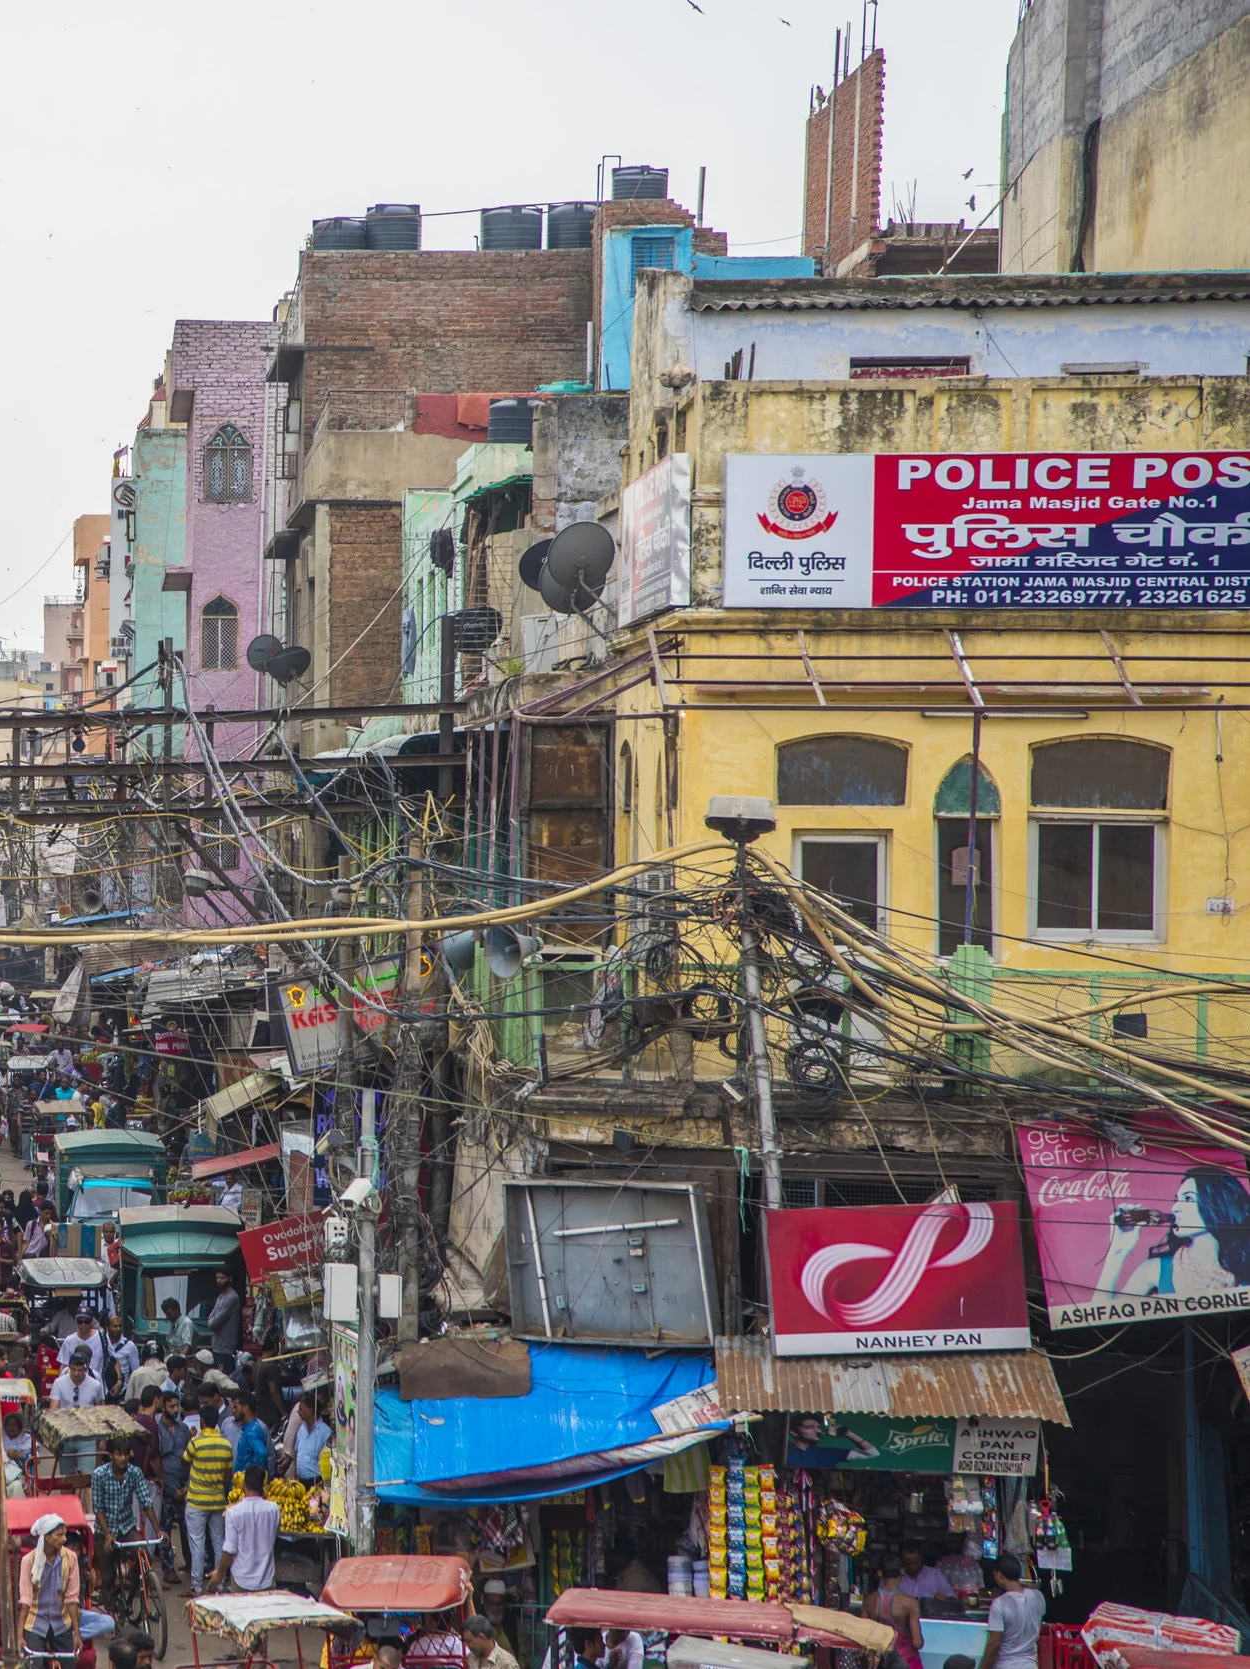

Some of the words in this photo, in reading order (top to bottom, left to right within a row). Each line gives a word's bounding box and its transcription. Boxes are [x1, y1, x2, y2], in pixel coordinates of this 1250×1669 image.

[897, 457, 1111, 491] POLICE
[962, 496, 1022, 510] Jama
[1029, 495, 1100, 512] Masjid
[1107, 495, 1161, 510] Gate
[1168, 495, 1217, 509] No.1
[900, 513, 1097, 559] पुलिस
[747, 550, 794, 571] दिल्ली
[799, 551, 846, 576] पुलिस
[968, 555, 1030, 568] जामा
[1034, 552, 1120, 569] मस्जिद
[1124, 551, 1165, 568] गेट
[1168, 551, 1199, 568] नं.
[1209, 555, 1220, 567] 1
[788, 583, 807, 595] सेवा
[809, 585, 832, 595] न्याय
[892, 577, 948, 587] POLICE
[952, 576, 1020, 588] STATION
[1024, 576, 1067, 588] JAMA
[1072, 576, 1131, 588] MASJID
[1135, 576, 1209, 588] CENTRAL
[931, 591, 968, 604] PH:
[974, 590, 1132, 607] 011-23269777,
[1138, 590, 1246, 604] 23261625
[1027, 1124, 1070, 1150] get
[1059, 1303, 1136, 1325] ASHFAQ
[1141, 1298, 1179, 1317] PAN
[855, 1335, 937, 1349] NANHEY
[943, 1333, 983, 1346] PAN
[889, 1431, 944, 1450] Sprite
[960, 1428, 1037, 1439] AHWAQ
[980, 1440, 1015, 1450] PAN
[962, 1451, 1032, 1462] CORNER
[958, 1460, 973, 1472] MOHD
